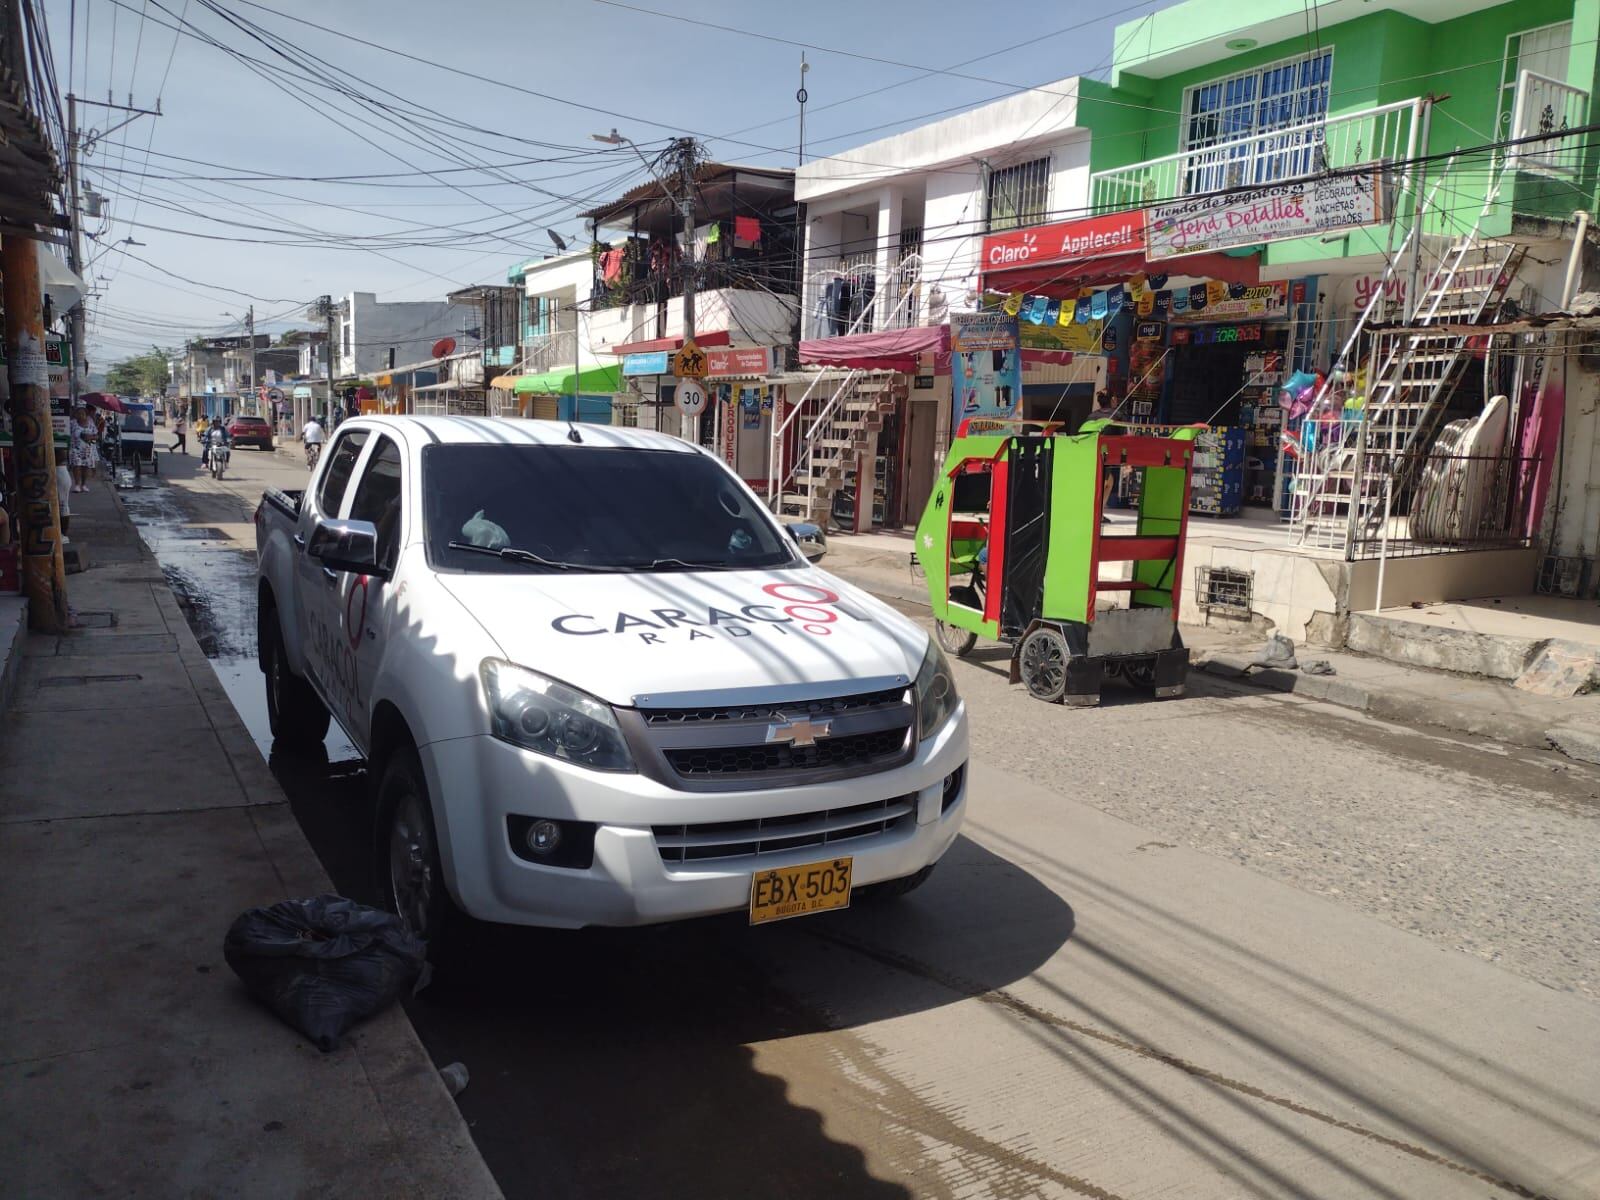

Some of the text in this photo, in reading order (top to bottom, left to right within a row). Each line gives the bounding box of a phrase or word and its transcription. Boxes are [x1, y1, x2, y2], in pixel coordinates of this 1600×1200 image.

[1154, 203, 1199, 218] Tienda
[1202, 198, 1220, 209] de
[1225, 196, 1304, 228] Detalles
[1315, 200, 1355, 215] ANCHETAS
[1315, 212, 1363, 228] VARIEDADES
[990, 225, 1132, 265] Claro Applecell
[711, 359, 728, 370] Claro
[684, 391, 699, 406] 30
[551, 604, 873, 636] CARACOL
[638, 623, 833, 645] RADIO
[755, 865, 849, 908] EBX 503
